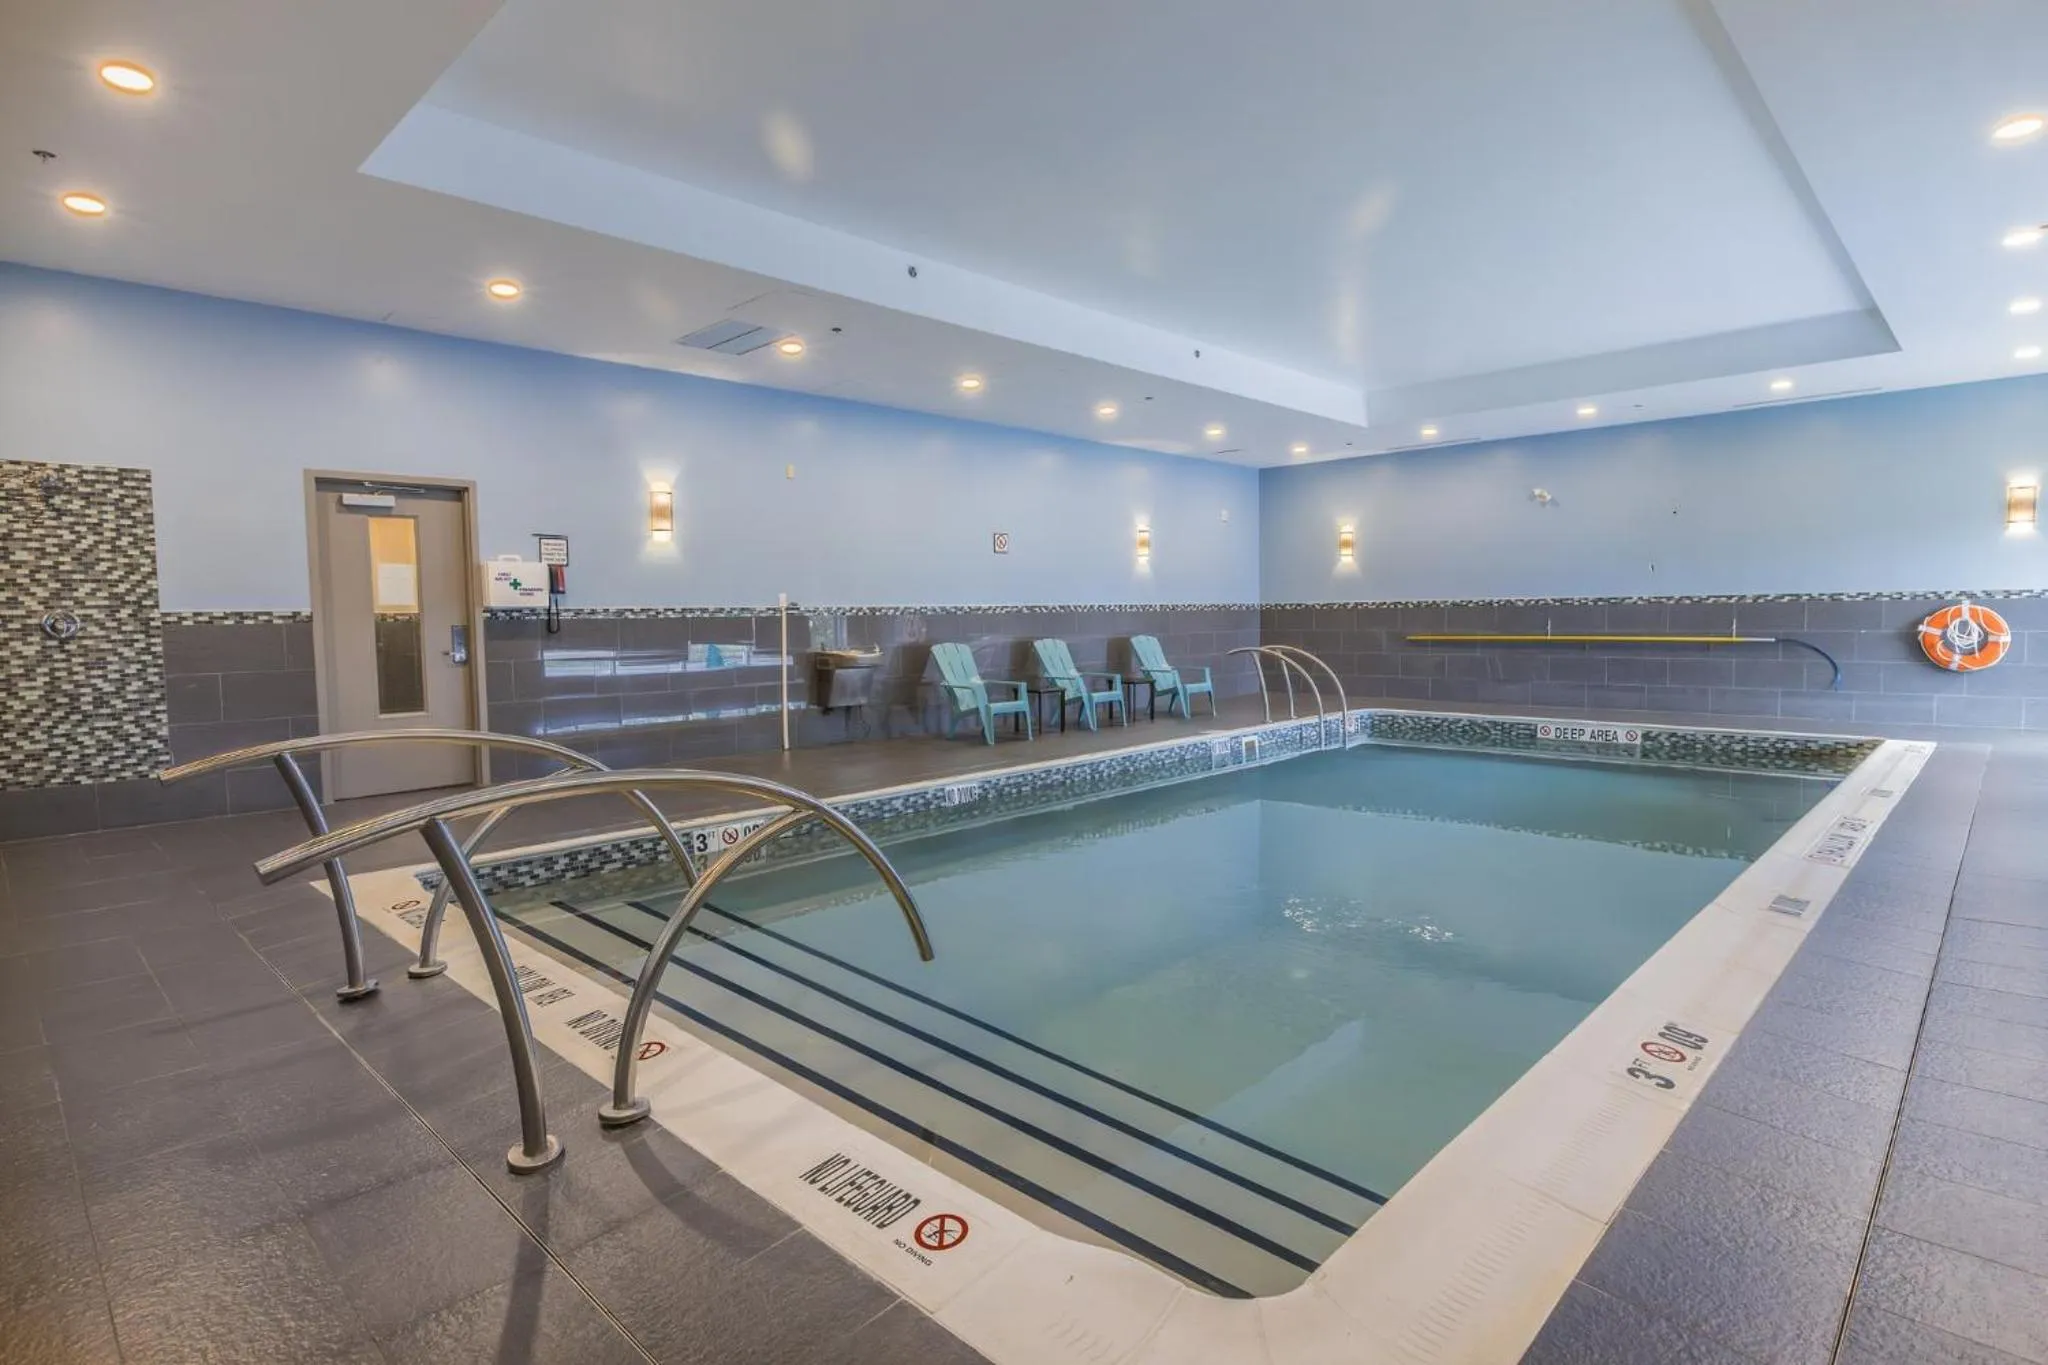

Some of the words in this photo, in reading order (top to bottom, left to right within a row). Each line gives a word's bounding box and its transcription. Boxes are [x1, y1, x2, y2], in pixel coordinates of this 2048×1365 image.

[1554, 727, 1586, 739] DEEP
[1589, 729, 1619, 742] AREA
[695, 833, 708, 852] 3
[1626, 1067, 1676, 1090] 3
[799, 1153, 850, 1186] NO
[817, 1164, 921, 1230] LIFEGUARD
[892, 1238, 906, 1248] NO
[904, 1247, 933, 1267] DIVING
